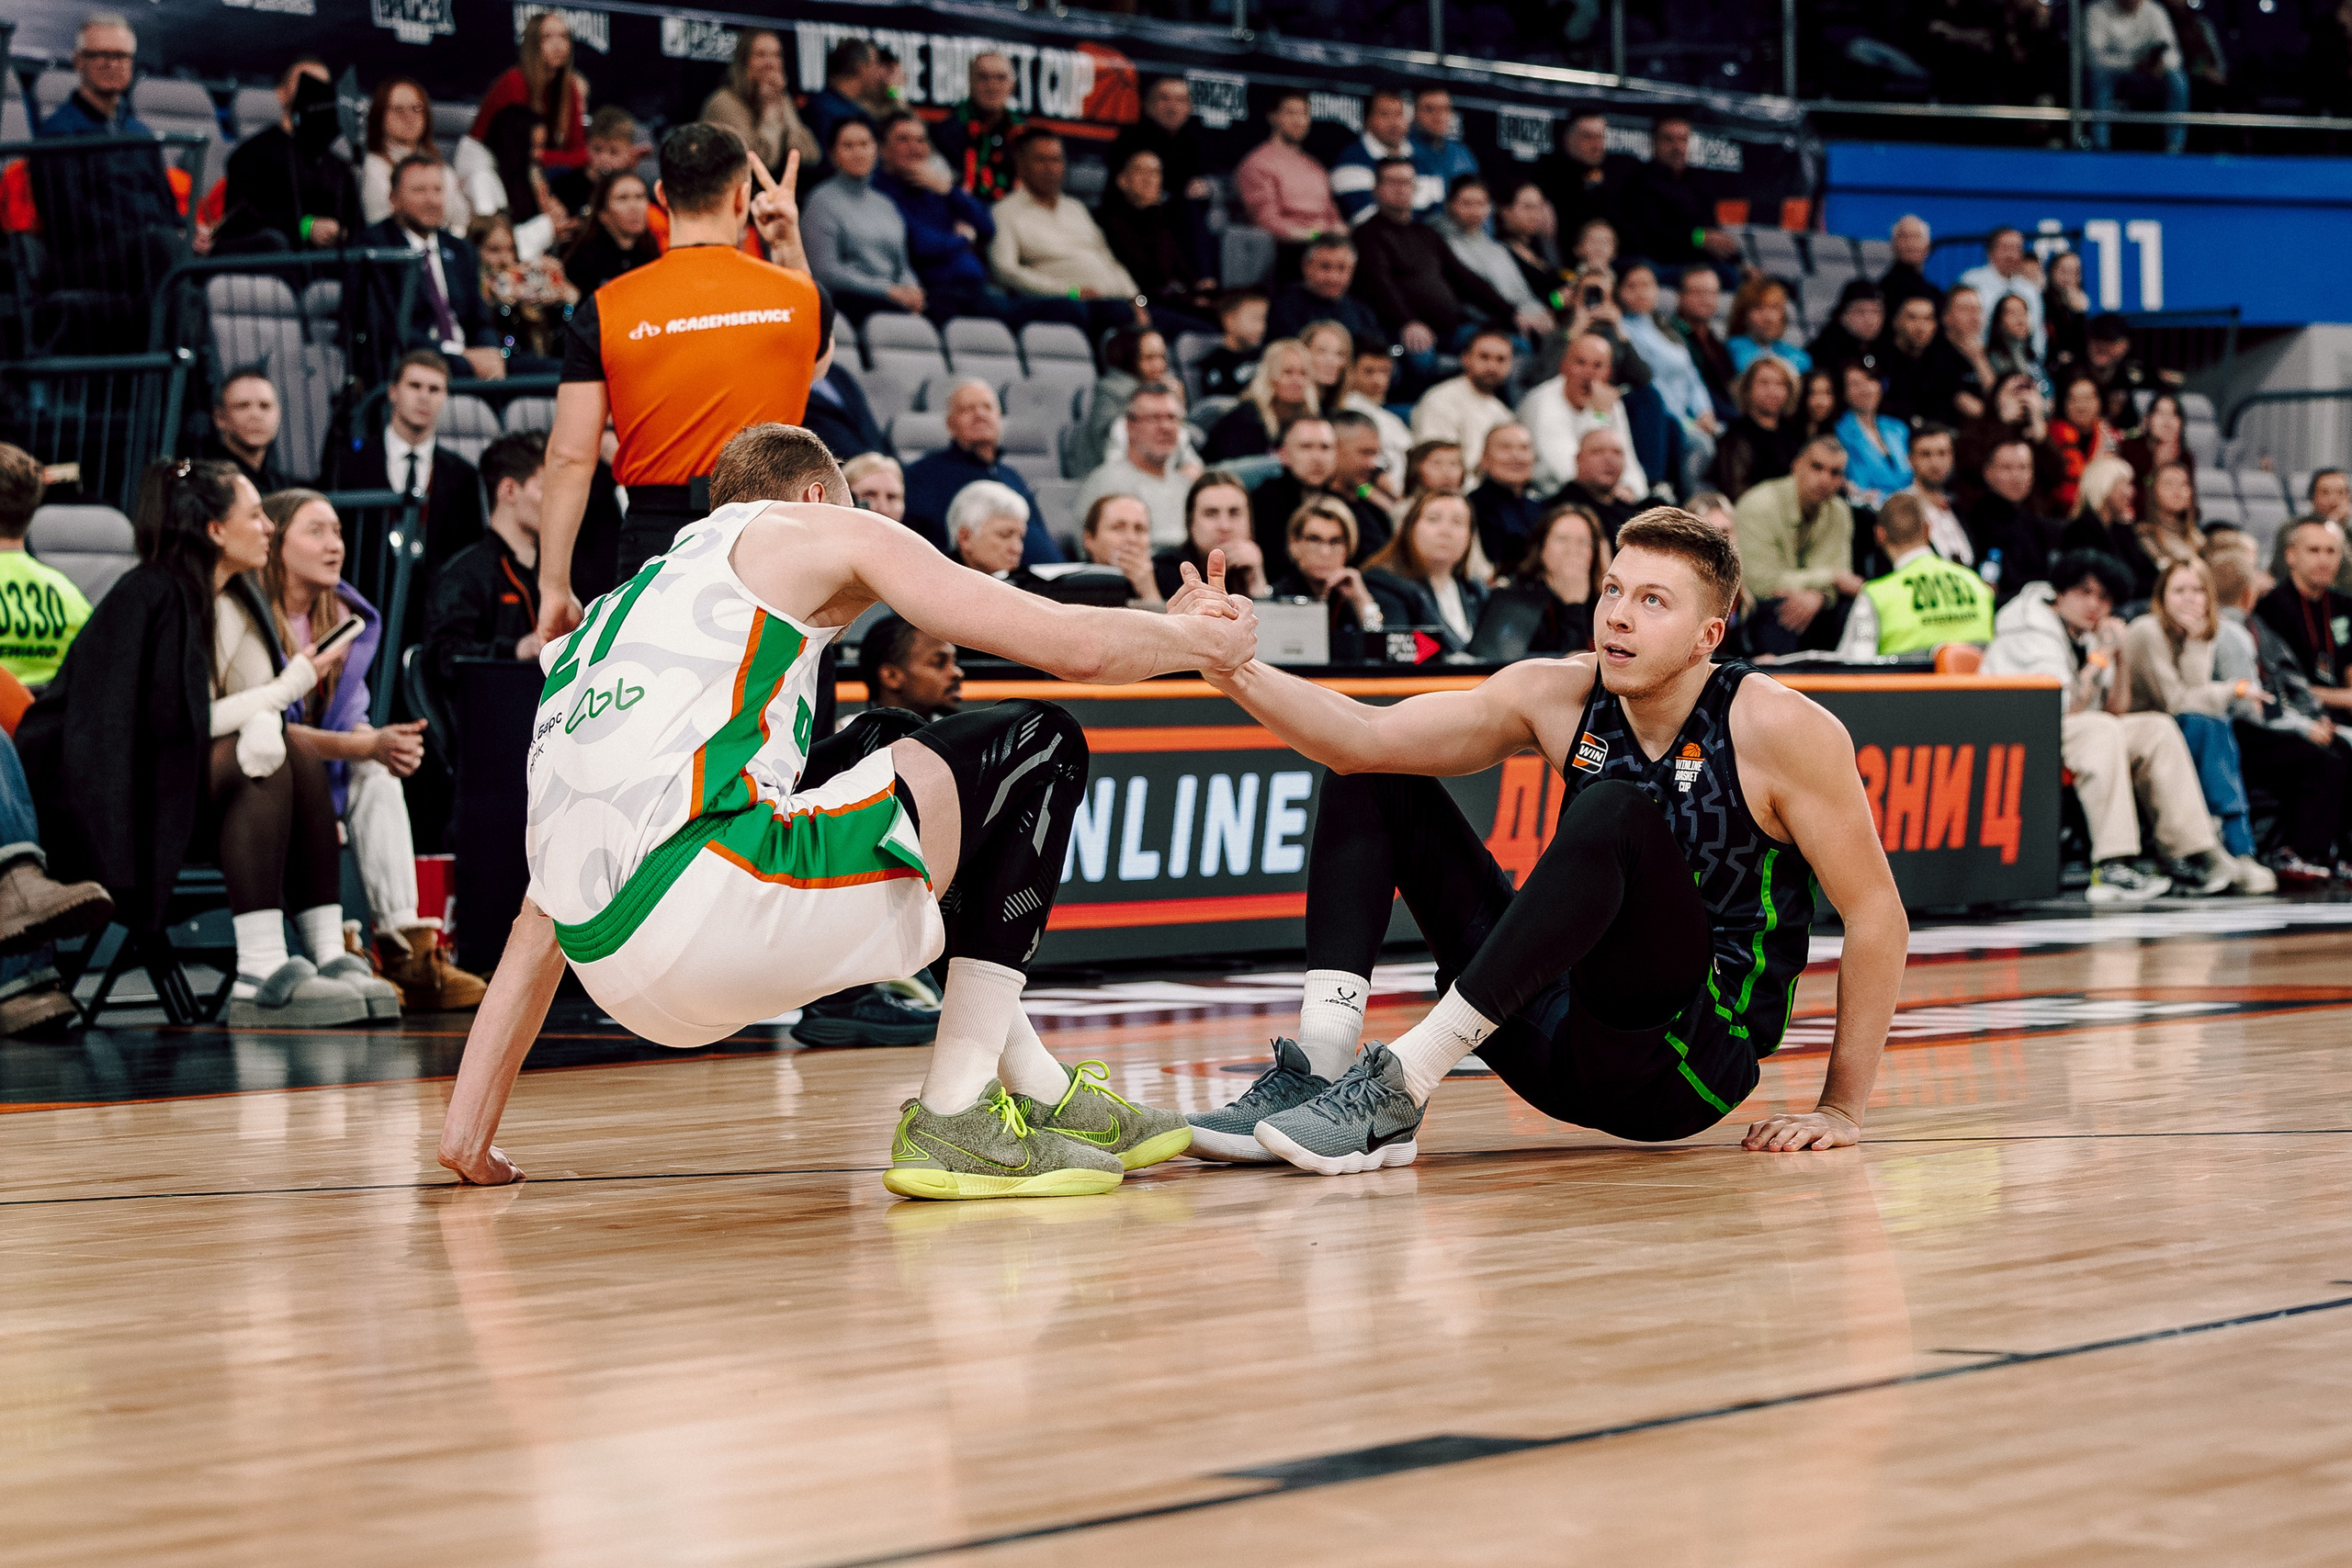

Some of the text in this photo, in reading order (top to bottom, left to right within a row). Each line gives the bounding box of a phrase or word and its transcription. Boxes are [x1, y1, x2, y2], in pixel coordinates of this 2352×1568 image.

[2085, 220, 2164, 312] 11
[665, 308, 792, 335] ACADEMSERVICE
[1578, 744, 1604, 762] WIN
[1675, 759, 1703, 772] WINLINE
[1674, 770, 1699, 783] BASKET
[1678, 781, 1691, 793] CUP
[1980, 742, 2026, 865] Ц
